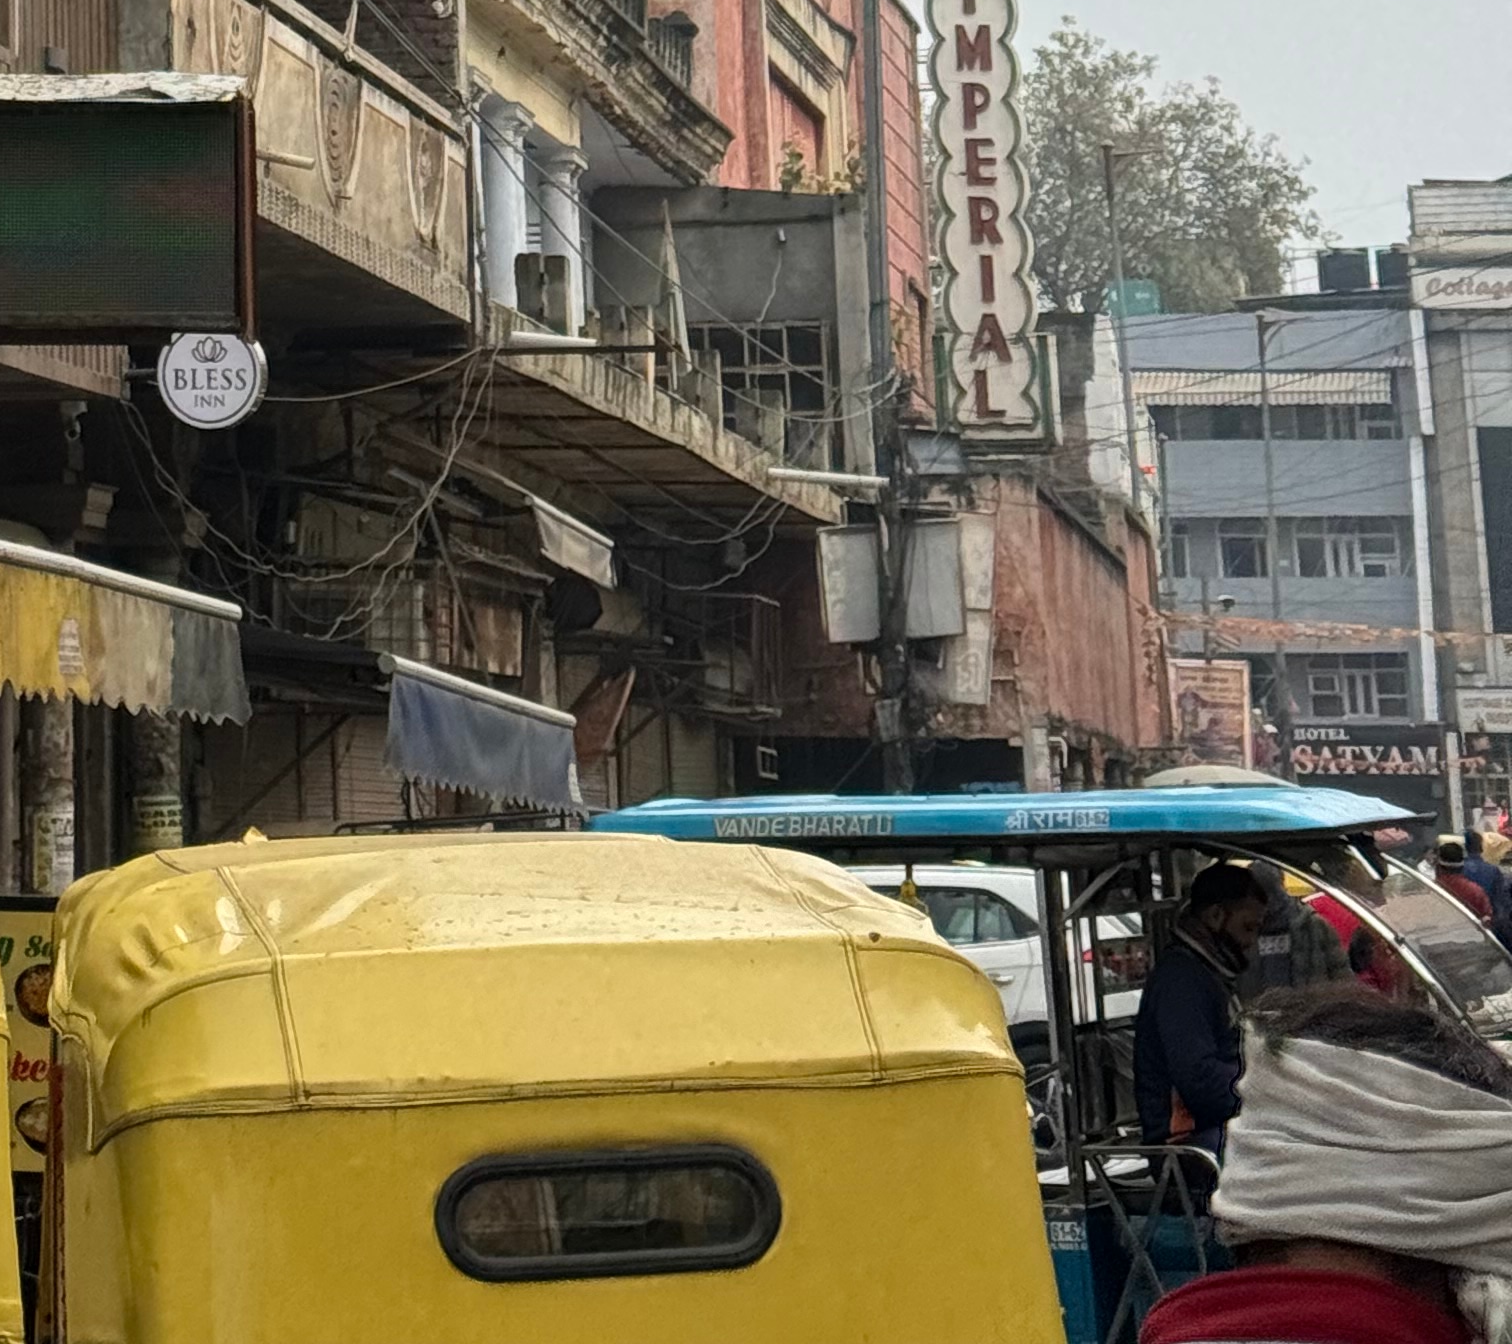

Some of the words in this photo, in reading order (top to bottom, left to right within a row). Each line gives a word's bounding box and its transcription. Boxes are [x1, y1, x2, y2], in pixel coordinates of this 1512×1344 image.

[172, 367, 248, 391] BLESS
[193, 394, 226, 409] INN
[1294, 728, 1350, 742] HOTEL
[1294, 744, 1441, 776] SATYAM
[714, 815, 786, 838] VANDE
[788, 814, 874, 837] BHARAT
[1030, 809, 1074, 829] राम
